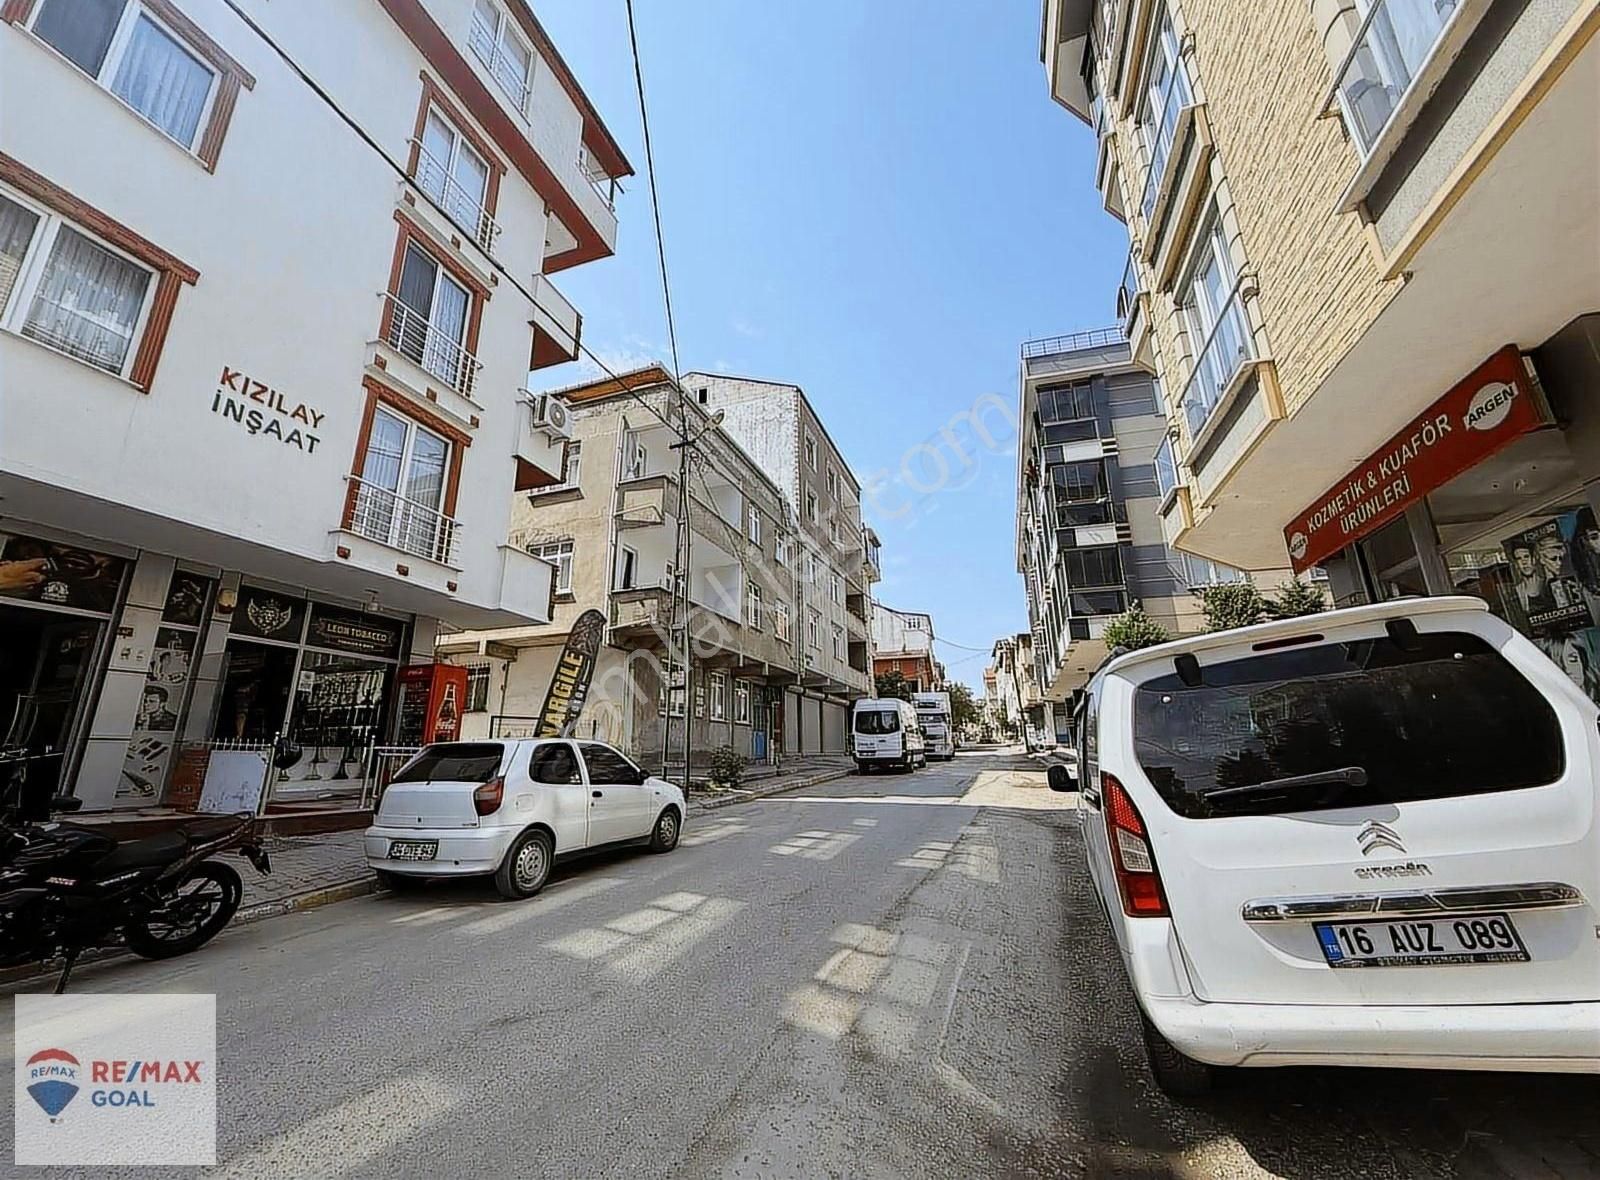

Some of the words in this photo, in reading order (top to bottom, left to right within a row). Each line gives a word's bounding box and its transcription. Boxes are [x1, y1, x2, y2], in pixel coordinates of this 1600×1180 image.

[211, 389, 320, 453] İNŞAAT
[220, 366, 325, 428] KIZILAY
[1468, 386, 1514, 425] ARGEN
[1307, 479, 1365, 533] KOZMETİK
[1366, 471, 1378, 488] &
[1379, 414, 1452, 480] KUAFÖR
[1340, 470, 1411, 534] ÜRÜNLERİ
[1339, 927, 1374, 955] 16
[1388, 924, 1444, 953] AUZ
[1453, 920, 1514, 950] 089
